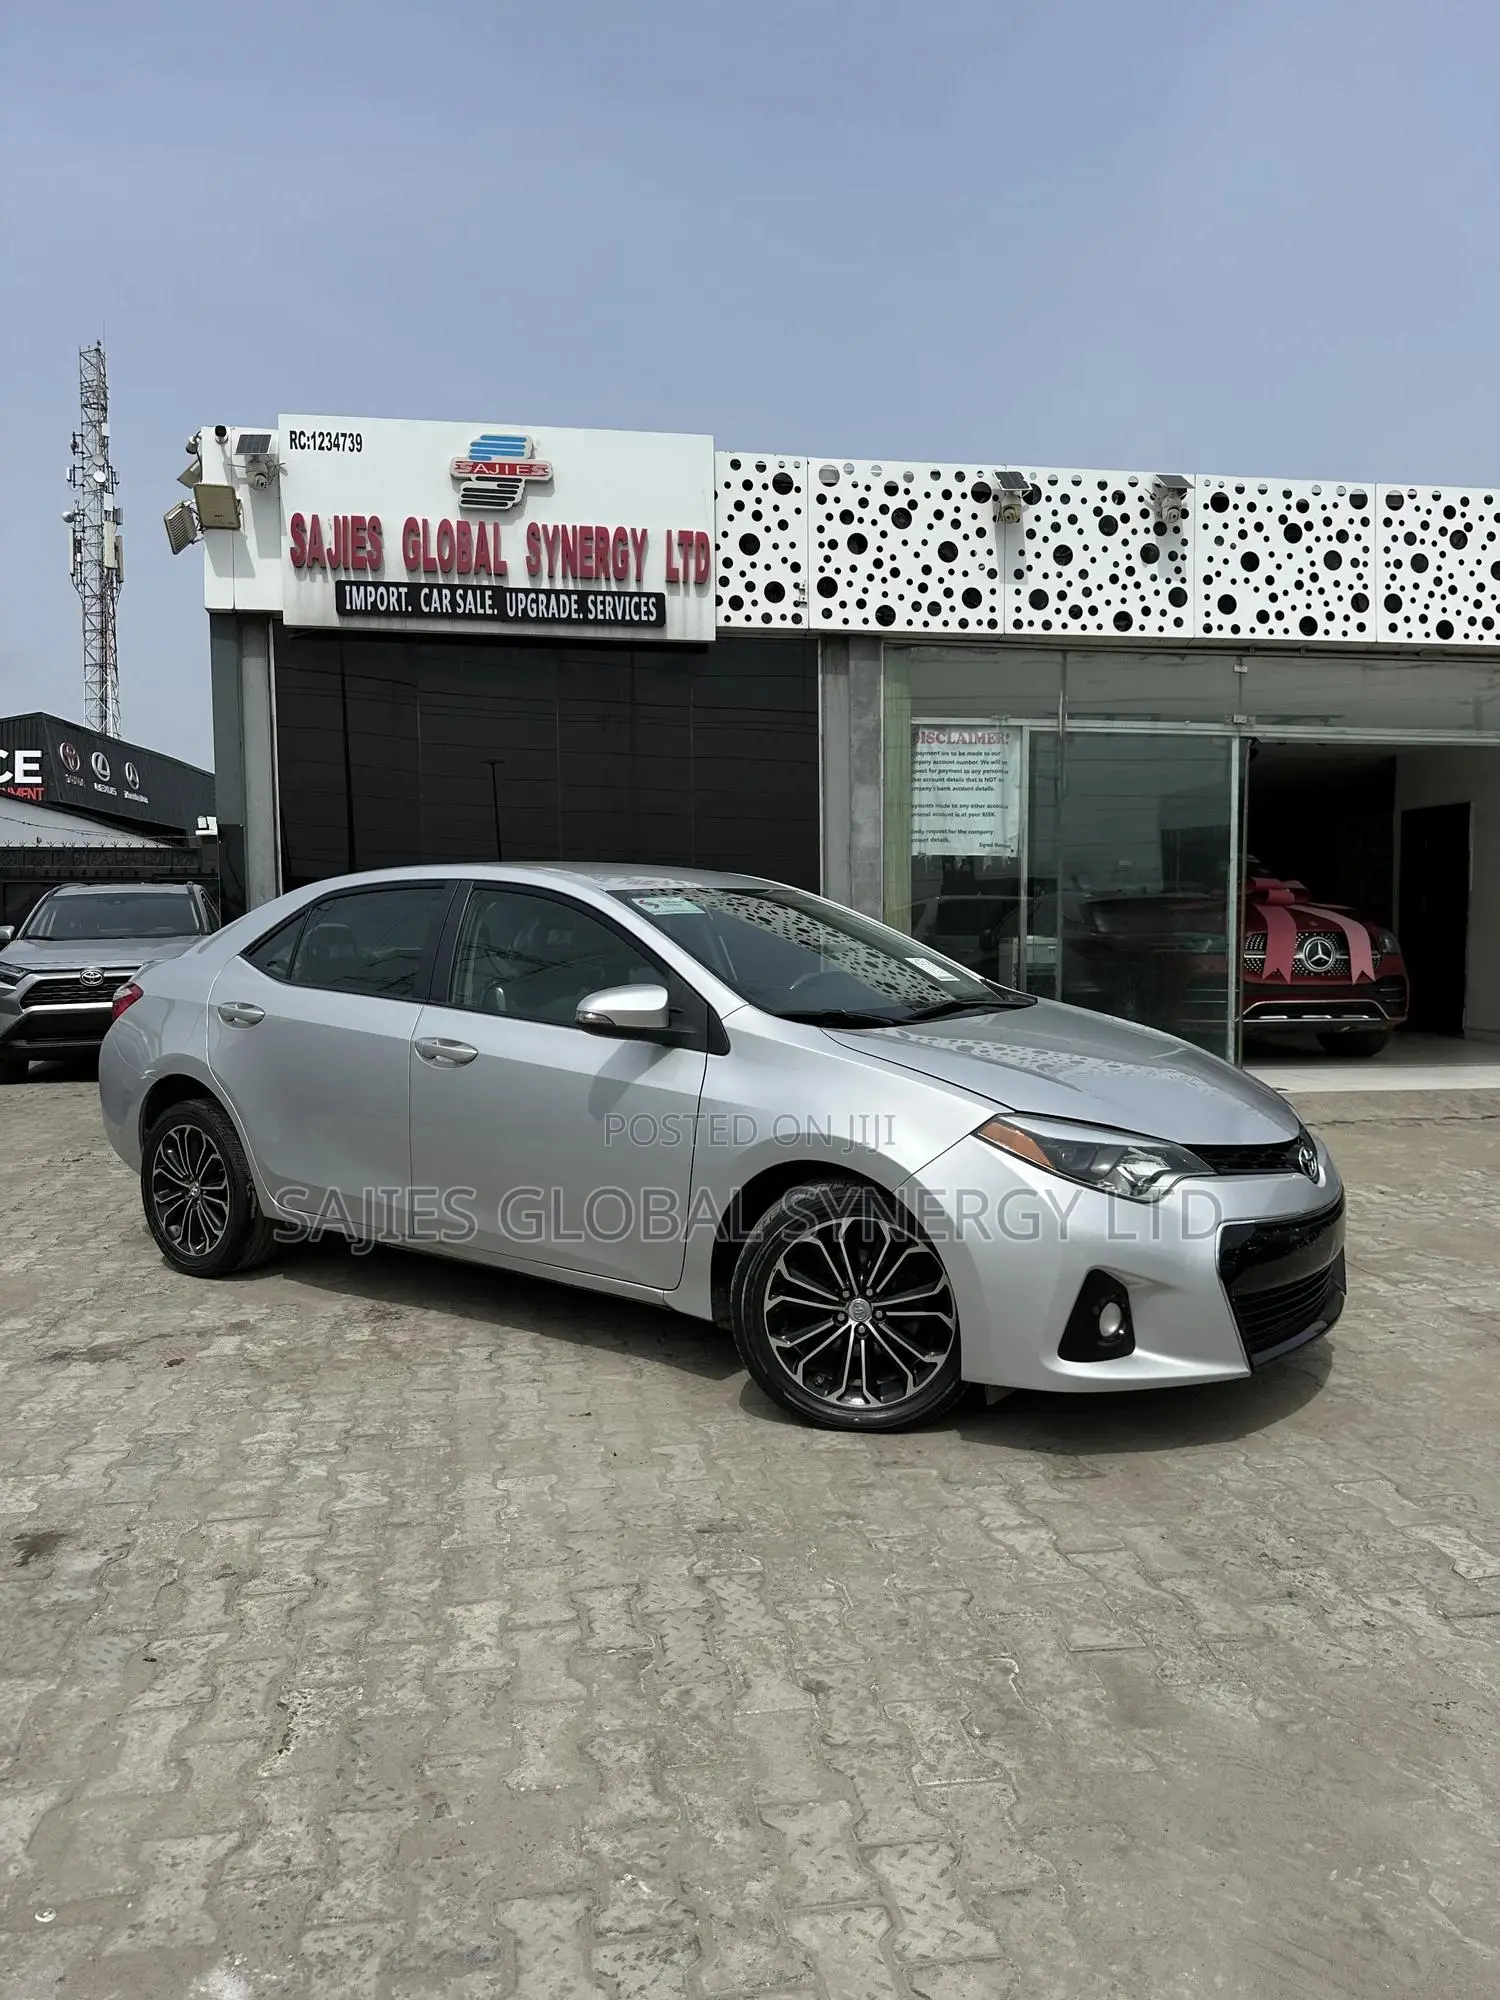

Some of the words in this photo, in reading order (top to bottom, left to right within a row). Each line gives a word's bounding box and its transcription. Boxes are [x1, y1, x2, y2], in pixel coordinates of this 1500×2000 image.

[289, 430, 363, 453] RC:1234739
[455, 460, 549, 477] SAJIES
[290, 512, 385, 571] SAJIES
[402, 516, 508, 576] GLOBAL
[526, 522, 648, 582] SYNERGY
[665, 529, 711, 584] LTD
[345, 585, 413, 612] IMPORT.
[420, 588, 451, 613] CAR
[456, 589, 498, 615] SALE.
[506, 592, 584, 619] UPGRADE.
[587, 594, 657, 621] SERVICES
